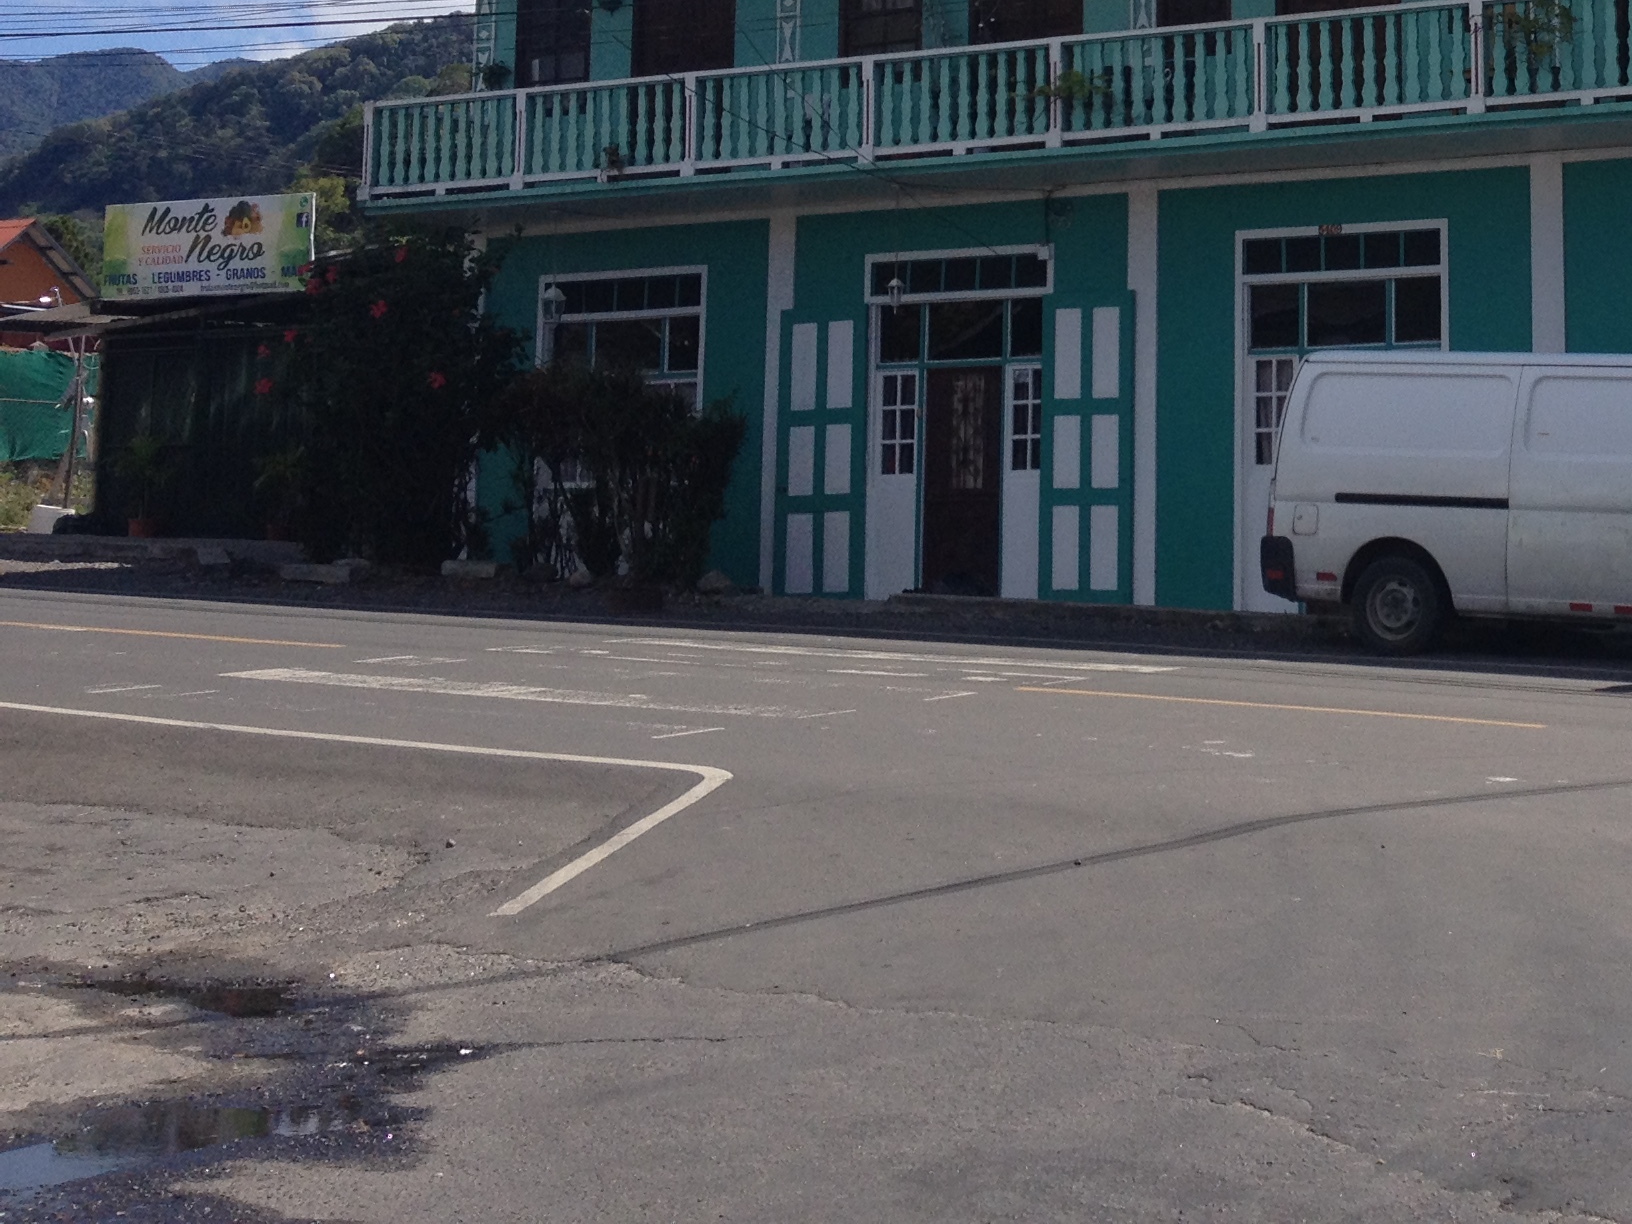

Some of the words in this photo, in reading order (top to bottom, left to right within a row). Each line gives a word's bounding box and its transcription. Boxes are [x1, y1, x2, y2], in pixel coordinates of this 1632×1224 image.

[141, 202, 218, 236] Monte
[141, 244, 181, 254] SERVICIO
[185, 234, 265, 270] Negro
[138, 257, 144, 266] Y
[145, 255, 184, 266] CALIDAD
[104, 273, 137, 286] FRUTAS
[151, 270, 210, 284] LEGUMBRES
[225, 267, 266, 280] GRANOS
